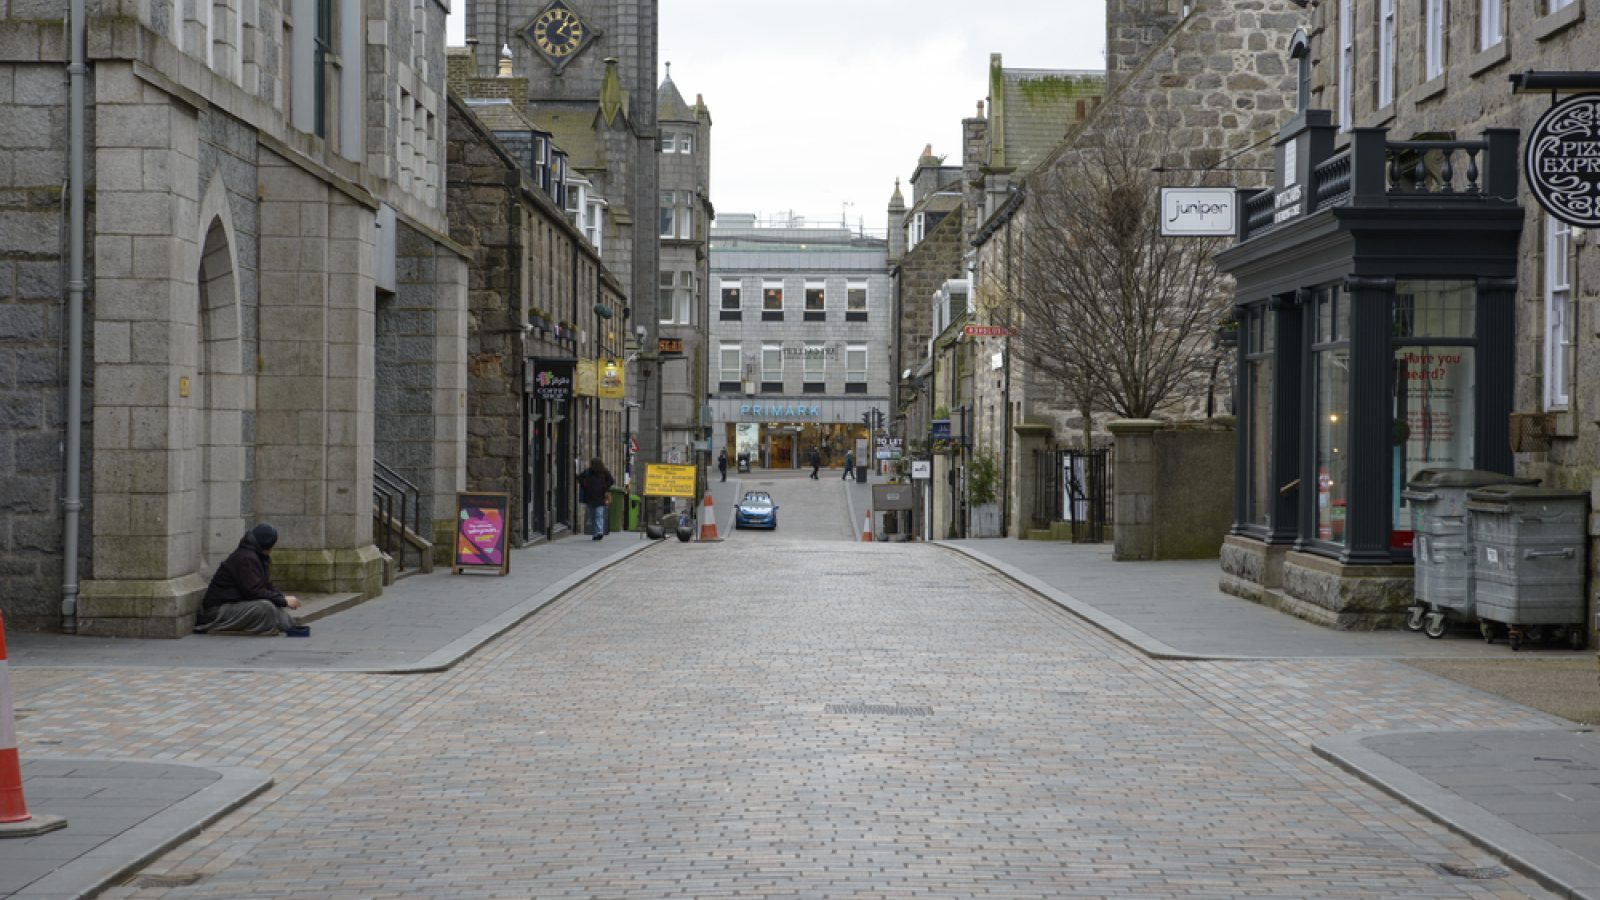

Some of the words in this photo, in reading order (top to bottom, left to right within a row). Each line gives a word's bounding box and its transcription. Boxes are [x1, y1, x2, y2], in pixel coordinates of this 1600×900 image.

[1562, 141, 1600, 157] PIZ
[1169, 200, 1229, 222] juniper
[1404, 352, 1434, 364] Have
[1438, 354, 1461, 366] you
[1401, 368, 1445, 380] heard?
[740, 404, 819, 416] PRIMARK
